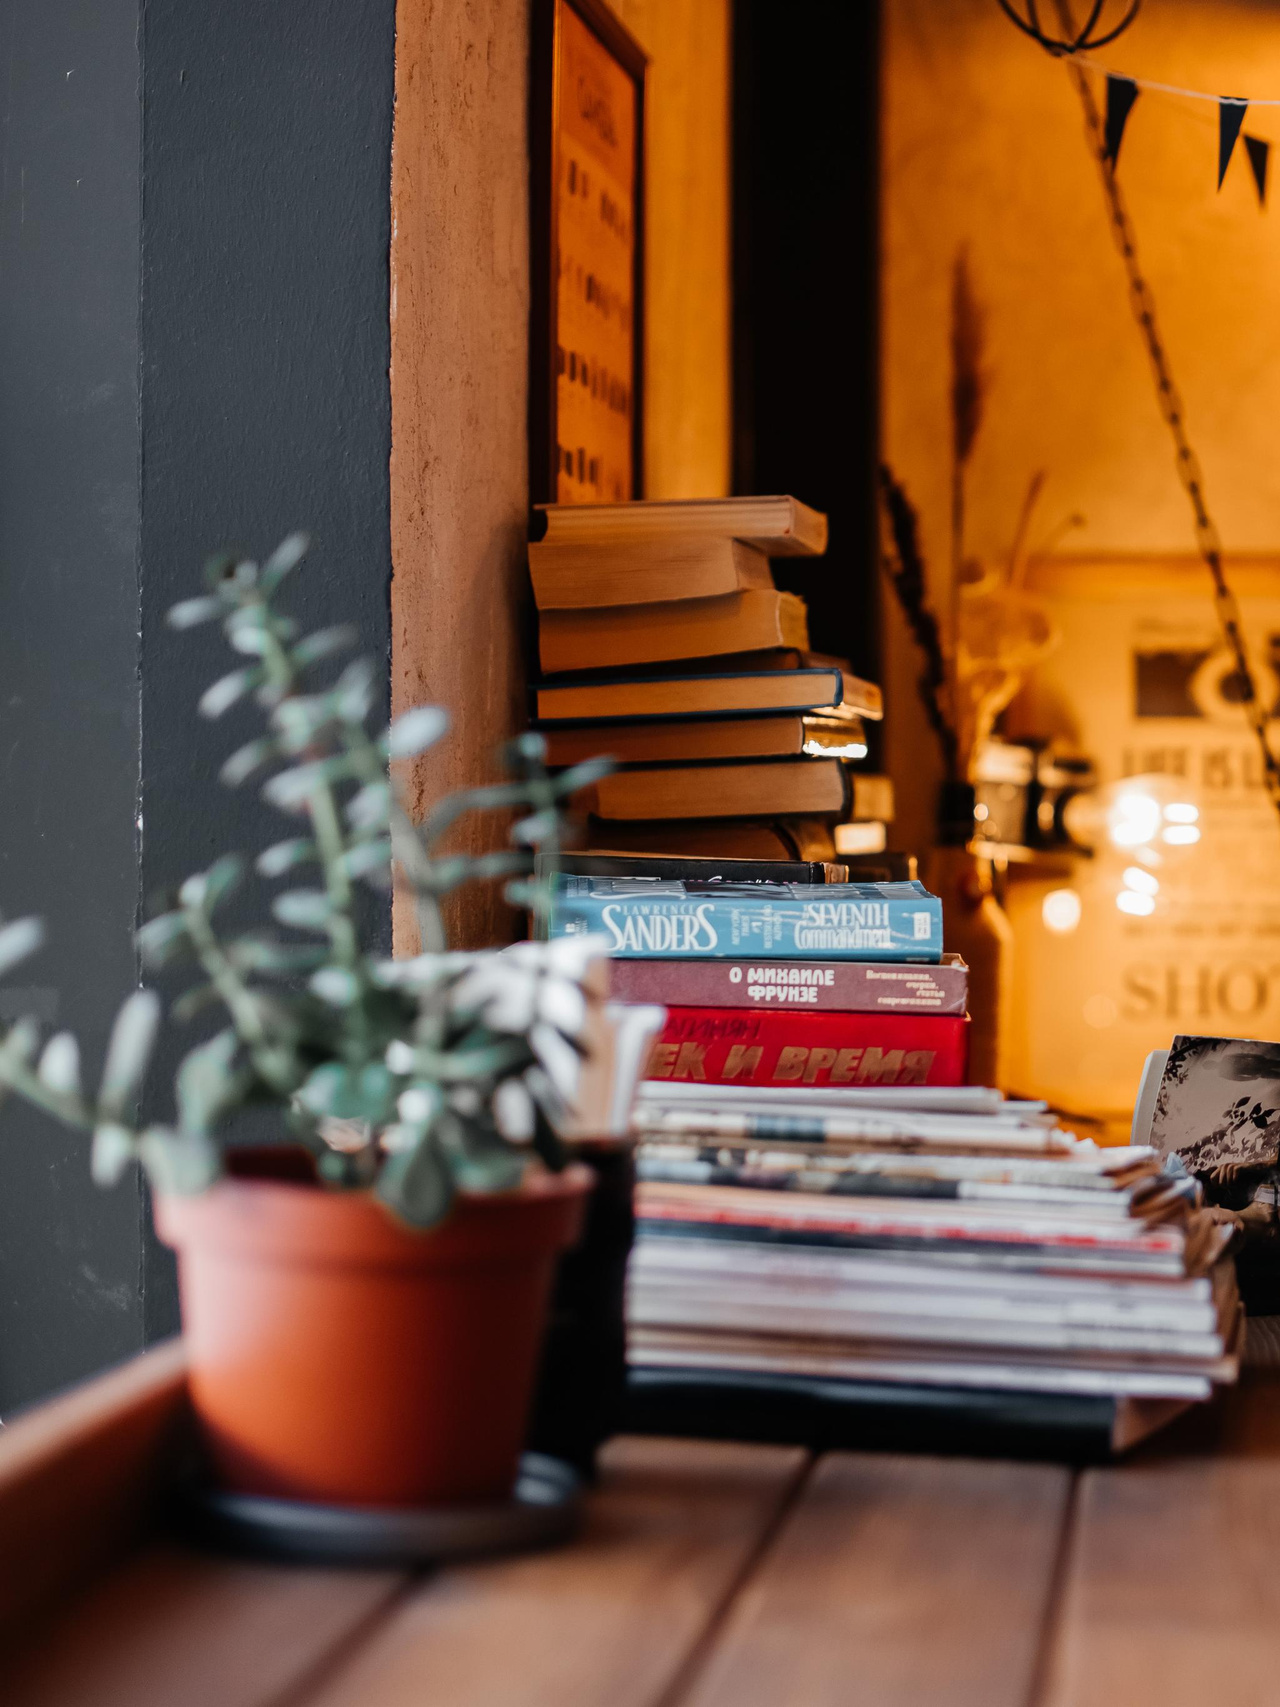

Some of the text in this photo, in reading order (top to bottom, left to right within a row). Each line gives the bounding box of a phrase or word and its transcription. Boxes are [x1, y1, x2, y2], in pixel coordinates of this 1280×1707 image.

[623, 904, 695, 916] LAWRENCE
[808, 903, 889, 927] SEVENTH
[601, 903, 718, 951] SANDERS
[729, 966, 835, 986] О МИХАИЛЕ
[747, 985, 819, 1004] ФРУНЗЕ
[662, 1017, 760, 1039] АГИНЯН
[647, 1041, 937, 1084] ЕК И ВРЕМЯ
